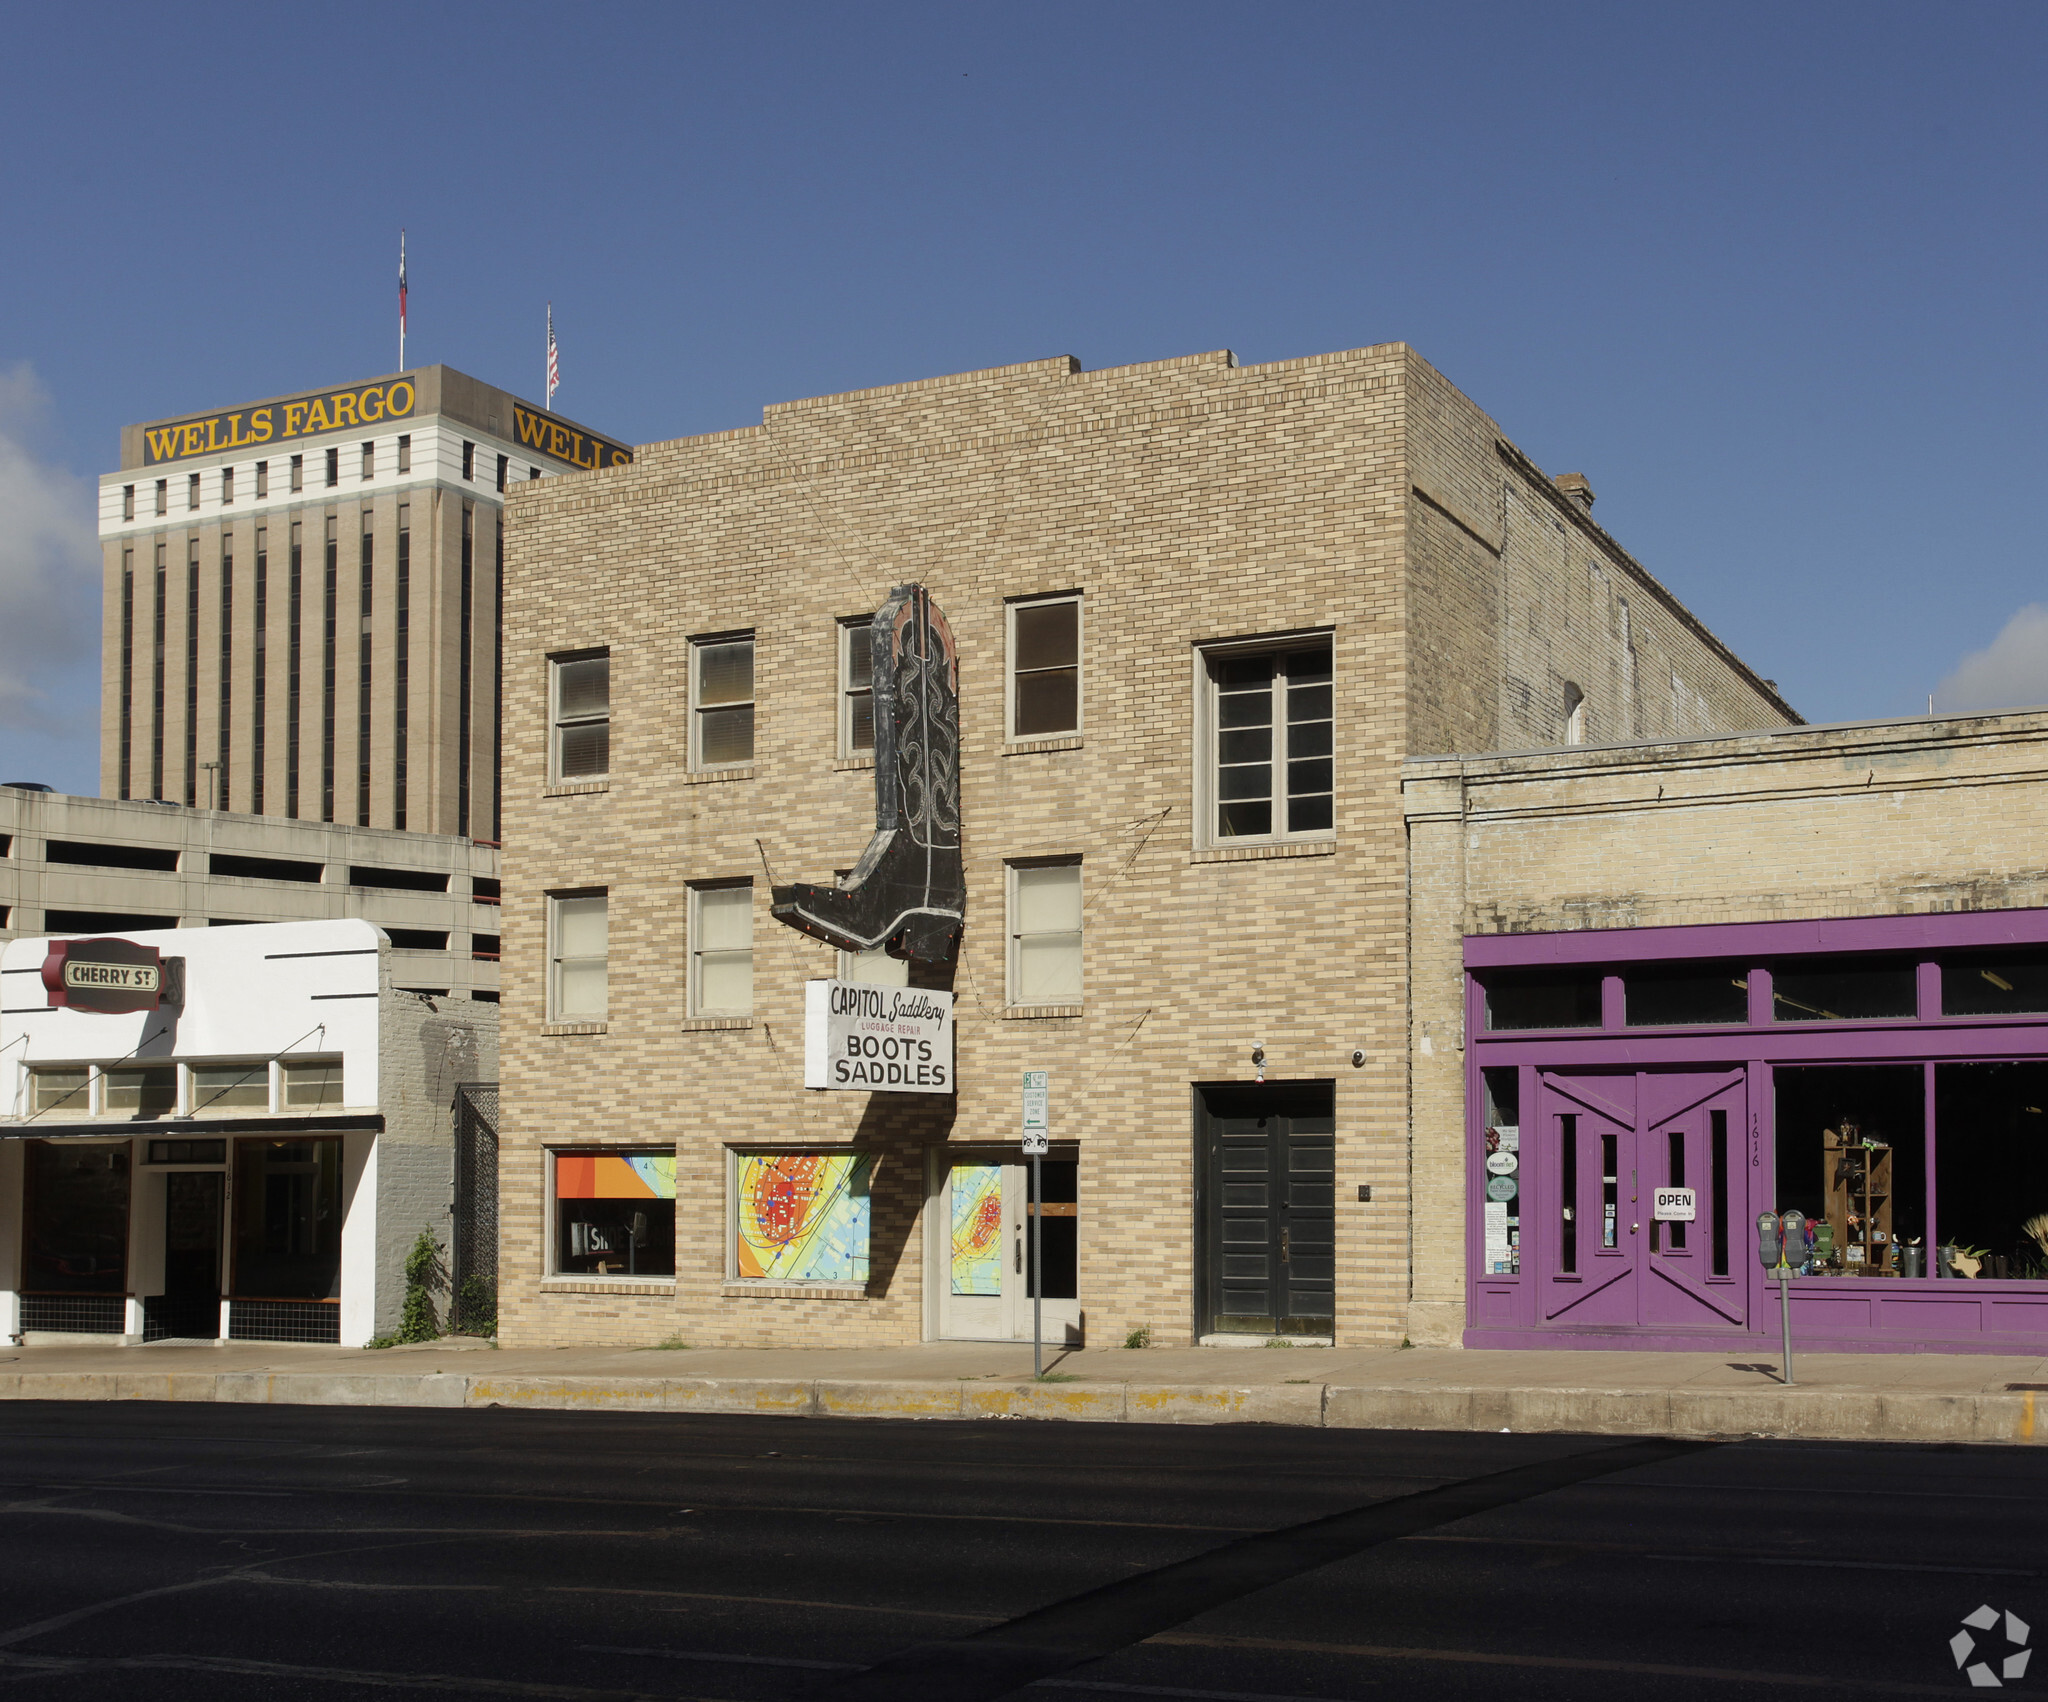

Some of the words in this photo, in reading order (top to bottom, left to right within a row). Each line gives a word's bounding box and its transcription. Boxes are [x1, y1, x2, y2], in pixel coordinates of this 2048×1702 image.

[145, 408, 273, 461] WELLS
[282, 381, 416, 438] FARGO
[73, 967, 130, 984] CHERRY
[831, 986, 887, 1019] CAPITOL
[888, 991, 945, 1030] Saddlery
[861, 1022, 895, 1034] LUGGAGE
[897, 1024, 921, 1035] REPAIR
[847, 1034, 932, 1062] BOOTS
[835, 1059, 946, 1086] SADDLES
[643, 1162, 648, 1170] 4
[1658, 1194, 1691, 1205] OPEN
[832, 1271, 838, 1280] 3
